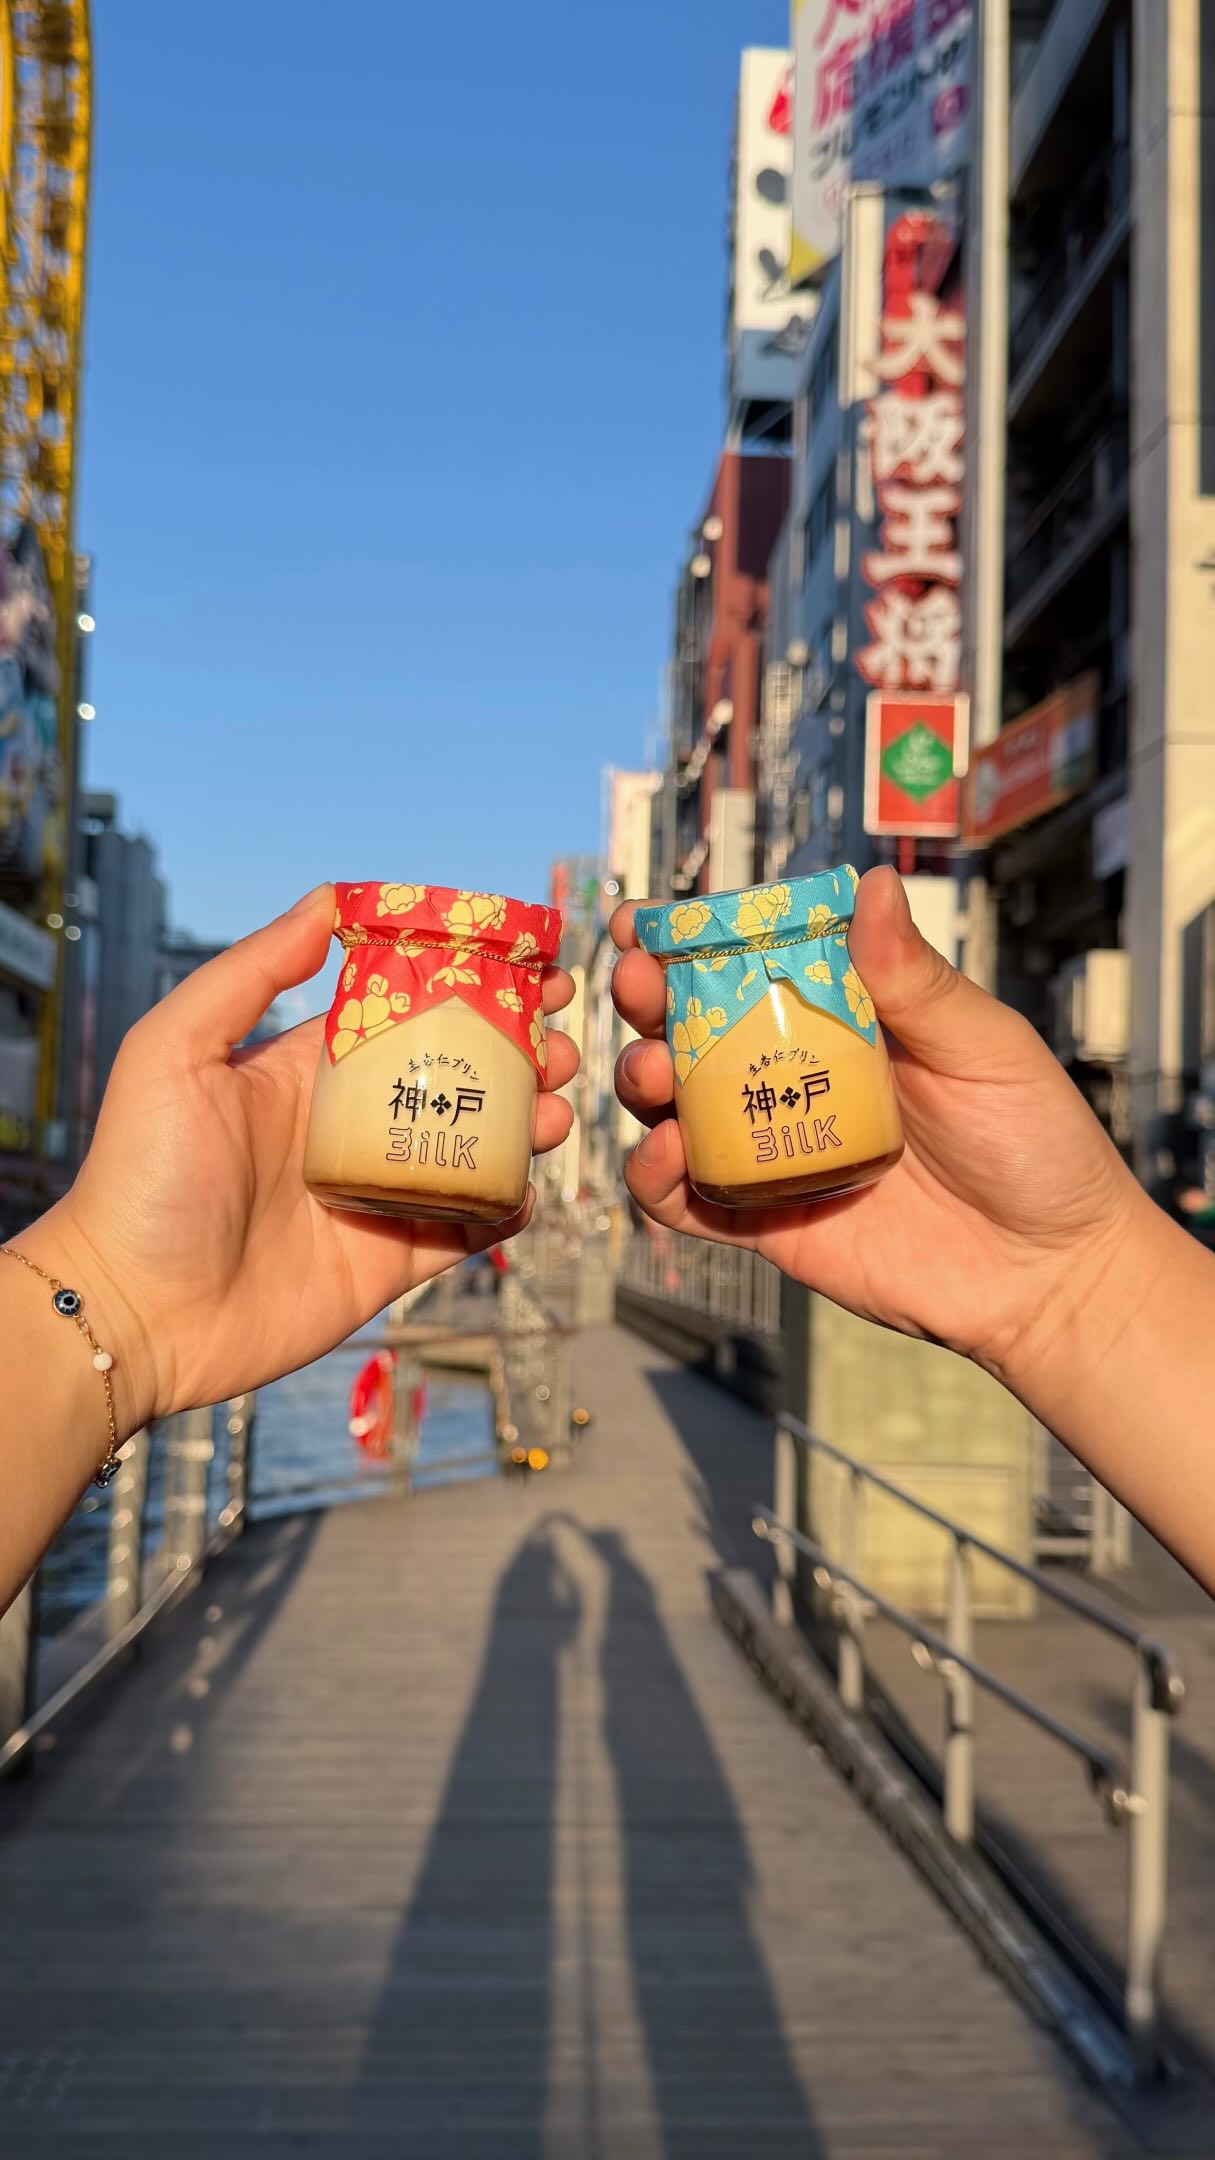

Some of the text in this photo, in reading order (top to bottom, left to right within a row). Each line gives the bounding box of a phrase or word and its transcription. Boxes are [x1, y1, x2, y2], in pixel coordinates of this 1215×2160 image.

[857, 292, 966, 691] 大阪王将
[748, 1047, 820, 1077] 生杏仁プリン
[387, 1077, 487, 1127] 神戸
[741, 1069, 831, 1125] 神戸
